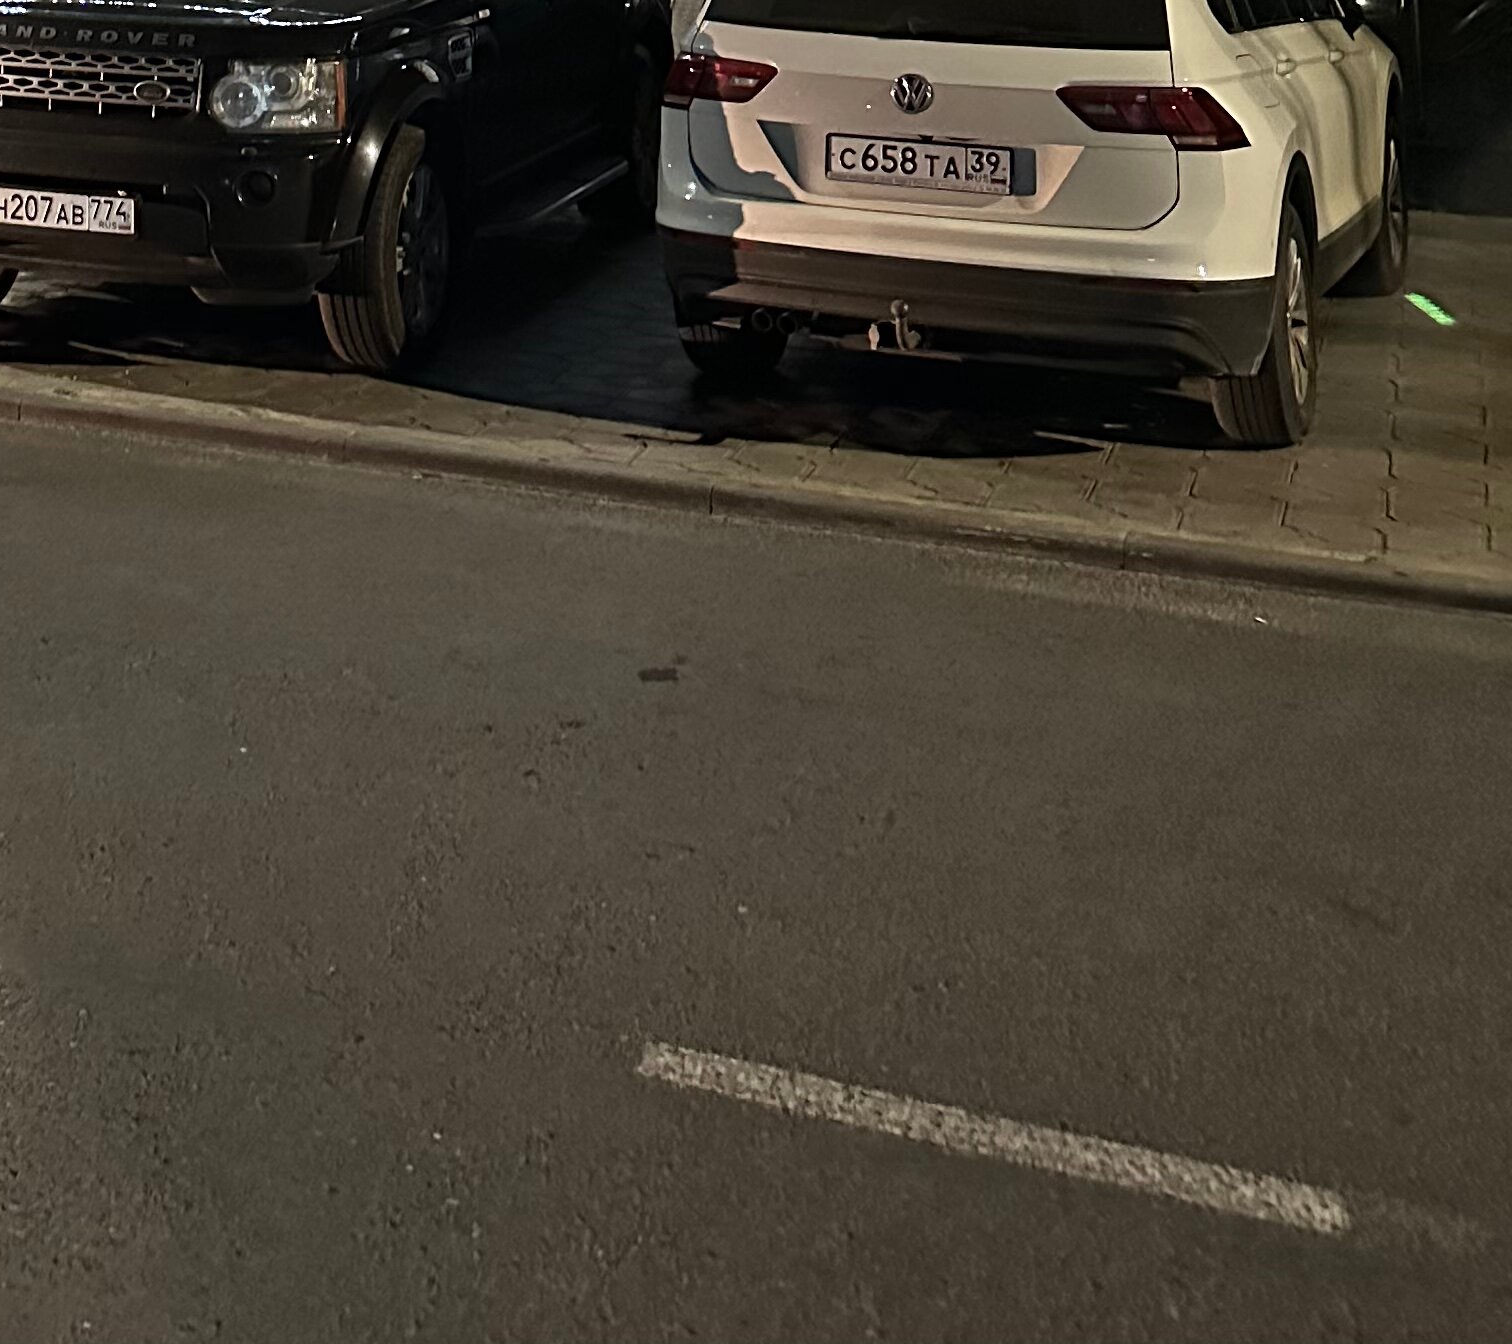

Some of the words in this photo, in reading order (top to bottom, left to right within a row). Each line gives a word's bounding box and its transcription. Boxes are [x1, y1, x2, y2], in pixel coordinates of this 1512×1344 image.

[75, 28, 197, 48] ROVER
[970, 150, 1001, 175] 39
[90, 198, 127, 223] 774
[98, 222, 117, 230] RUS
